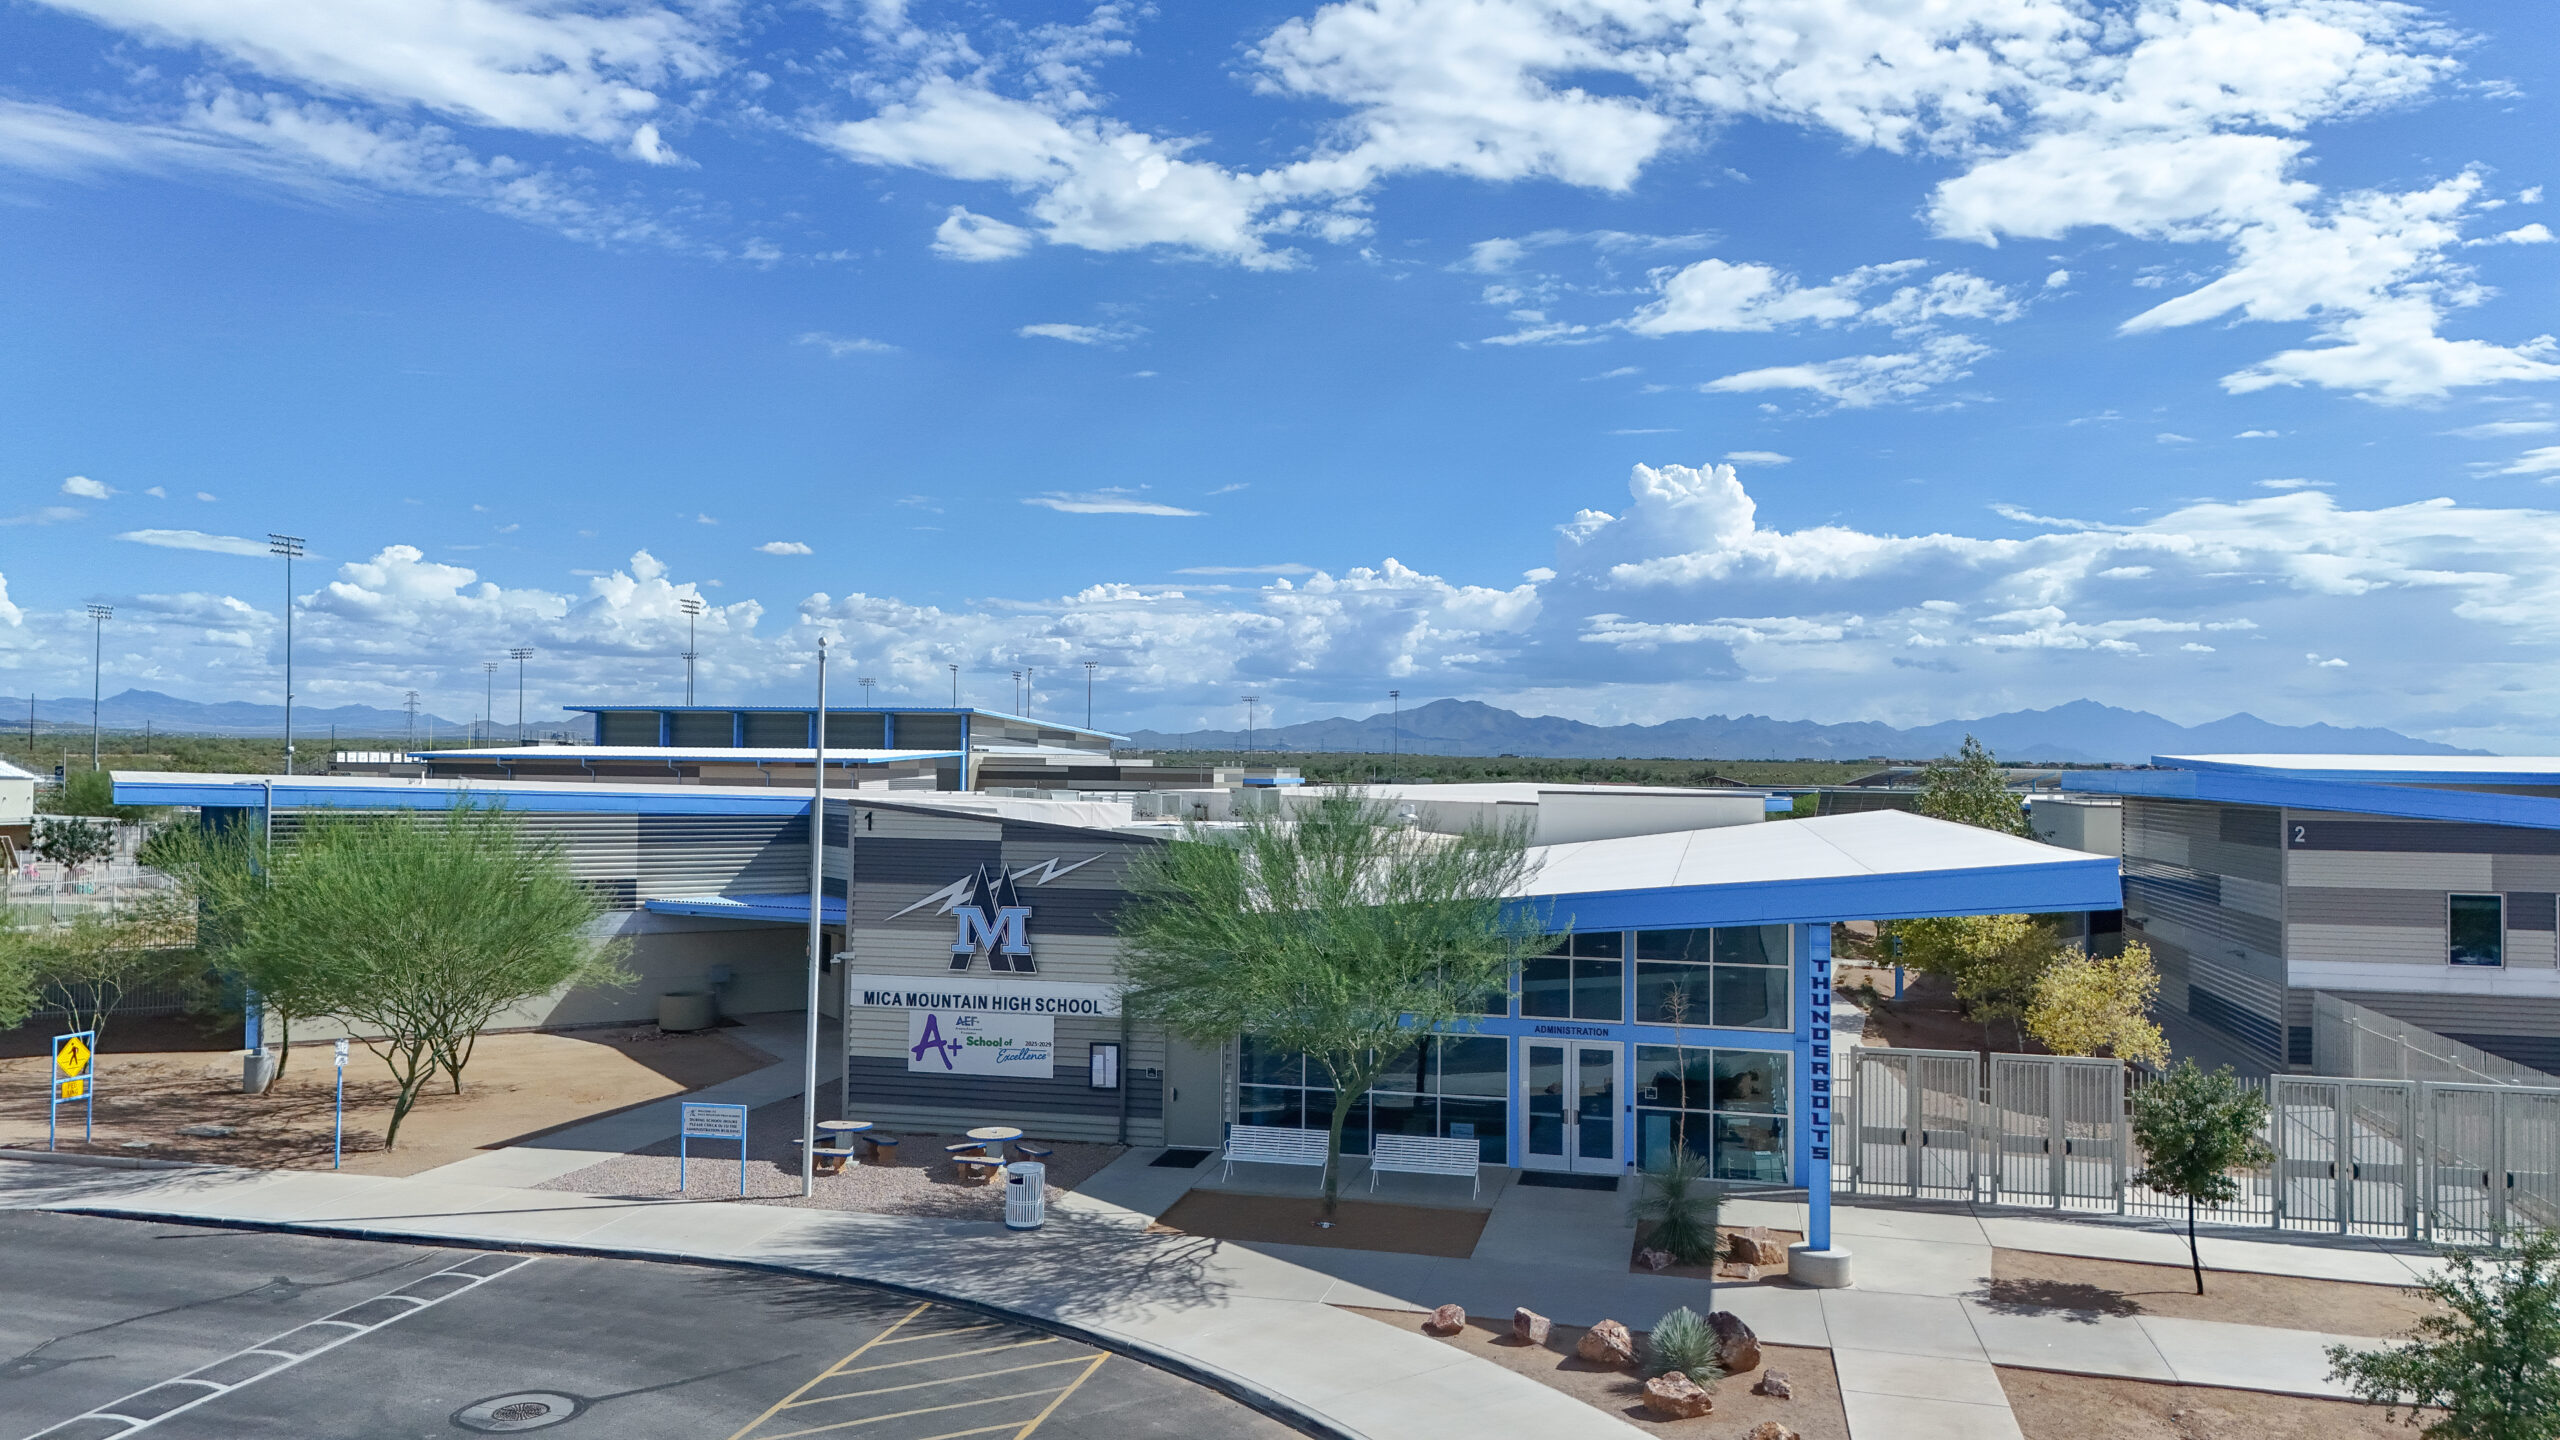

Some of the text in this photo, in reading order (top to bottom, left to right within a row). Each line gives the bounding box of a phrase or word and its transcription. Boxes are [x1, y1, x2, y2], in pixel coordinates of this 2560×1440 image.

[864, 811, 873, 831] 1
[2295, 825, 2305, 842] 2
[863, 990, 1102, 1014] MICA MOUNTAIN HIGH SCHOOL
[1534, 1025, 1609, 1037] ADMINISTRATION
[911, 1013, 963, 1071] A+
[966, 1036, 1013, 1047] School of
[996, 1048, 1047, 1064] Excellence
[1811, 959, 1830, 1160] THUNDERBOLTS
